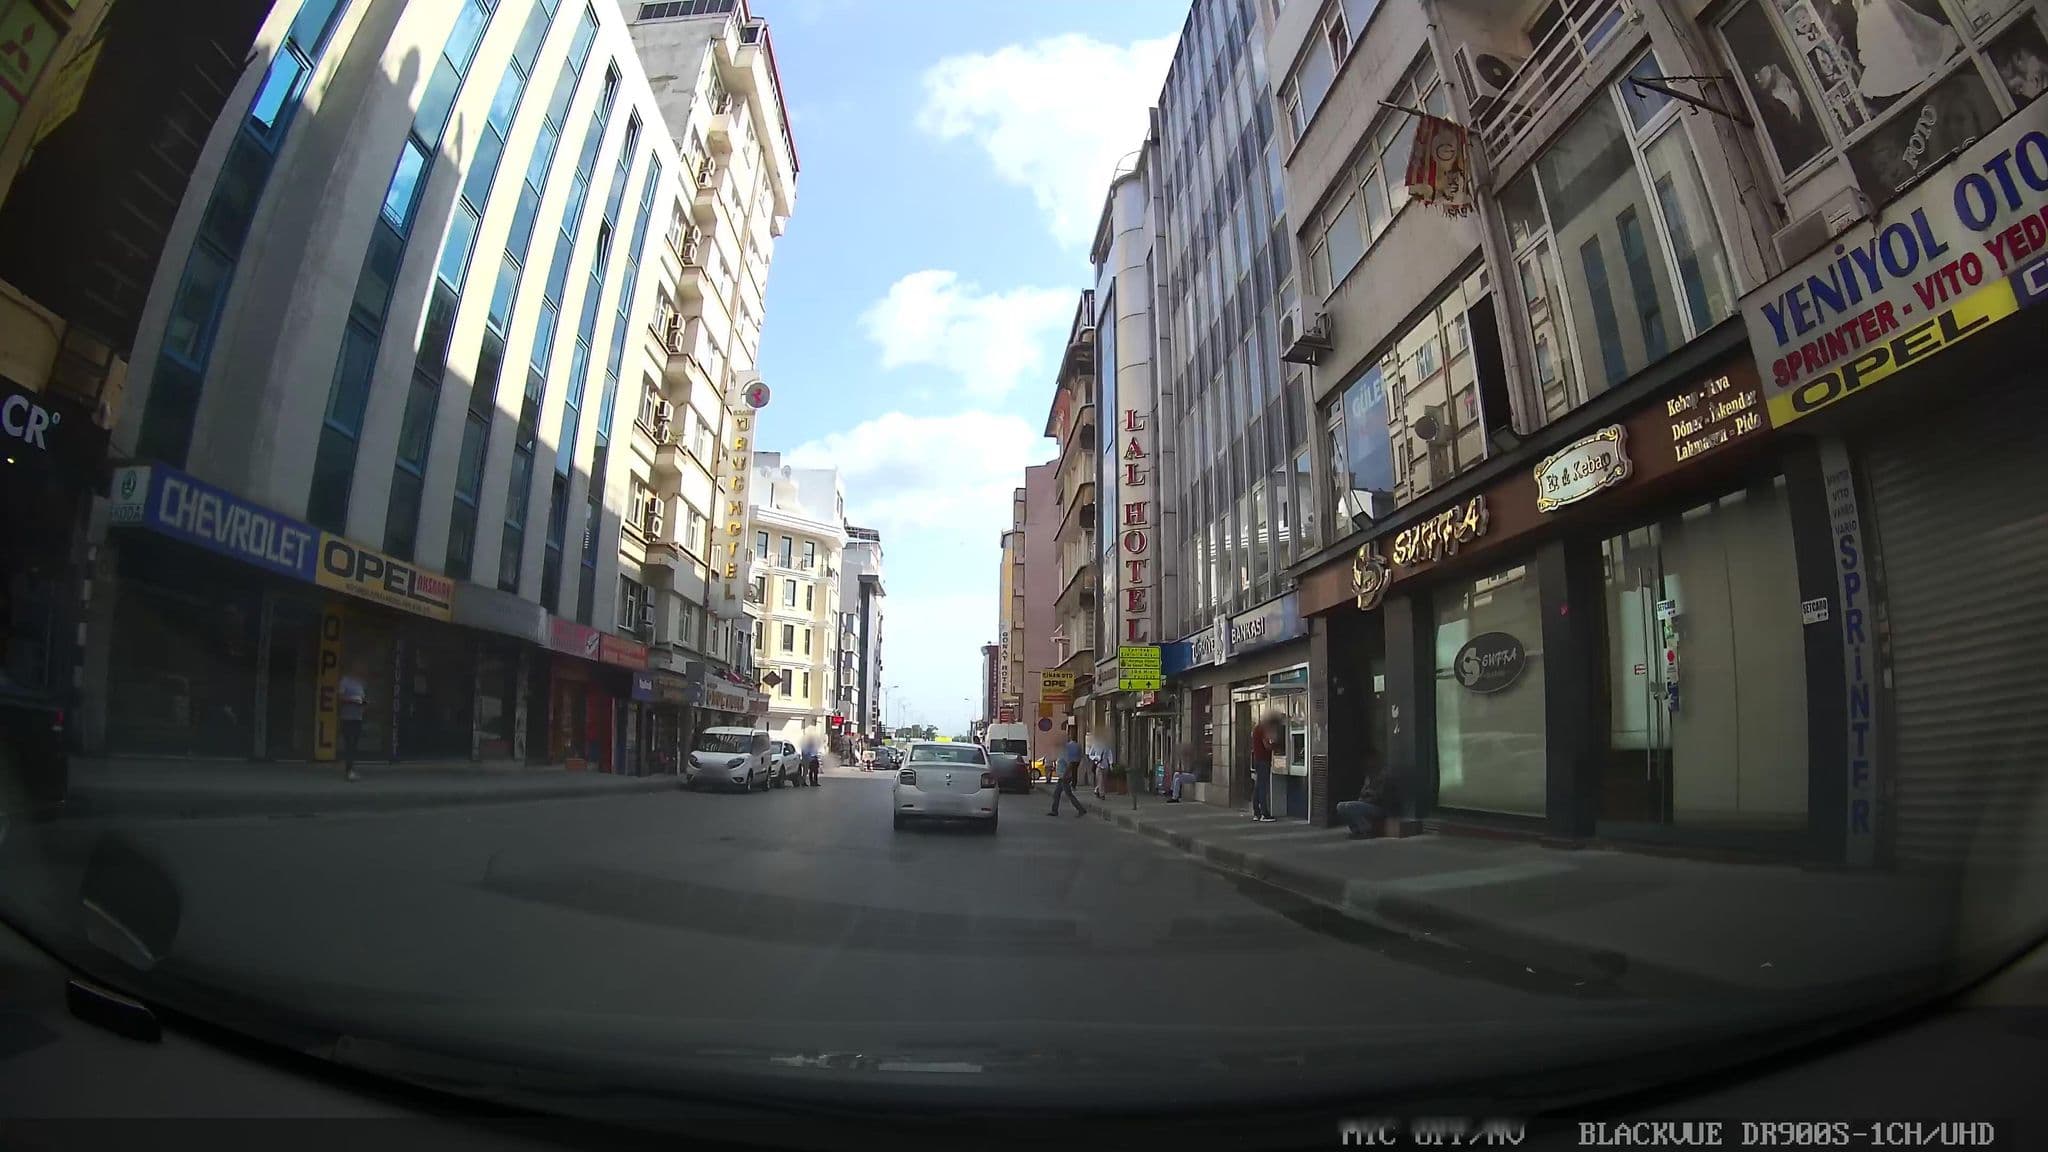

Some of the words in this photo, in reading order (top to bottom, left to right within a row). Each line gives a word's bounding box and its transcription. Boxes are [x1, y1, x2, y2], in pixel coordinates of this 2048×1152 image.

[1954, 131, 2048, 232] OTO
[1773, 300, 1900, 388] SPRINTER
[1912, 252, 1983, 310] VITO
[1983, 205, 2048, 271] YED
[1791, 310, 1989, 413] OPEL
[1124, 409, 1146, 486] LAL
[1573, 452, 1611, 481] Kebap
[158, 476, 311, 570] CHEVROLET
[1123, 501, 1147, 643] HOTEL
[324, 540, 449, 610] OPEL
[319, 616, 340, 748] OPEL
